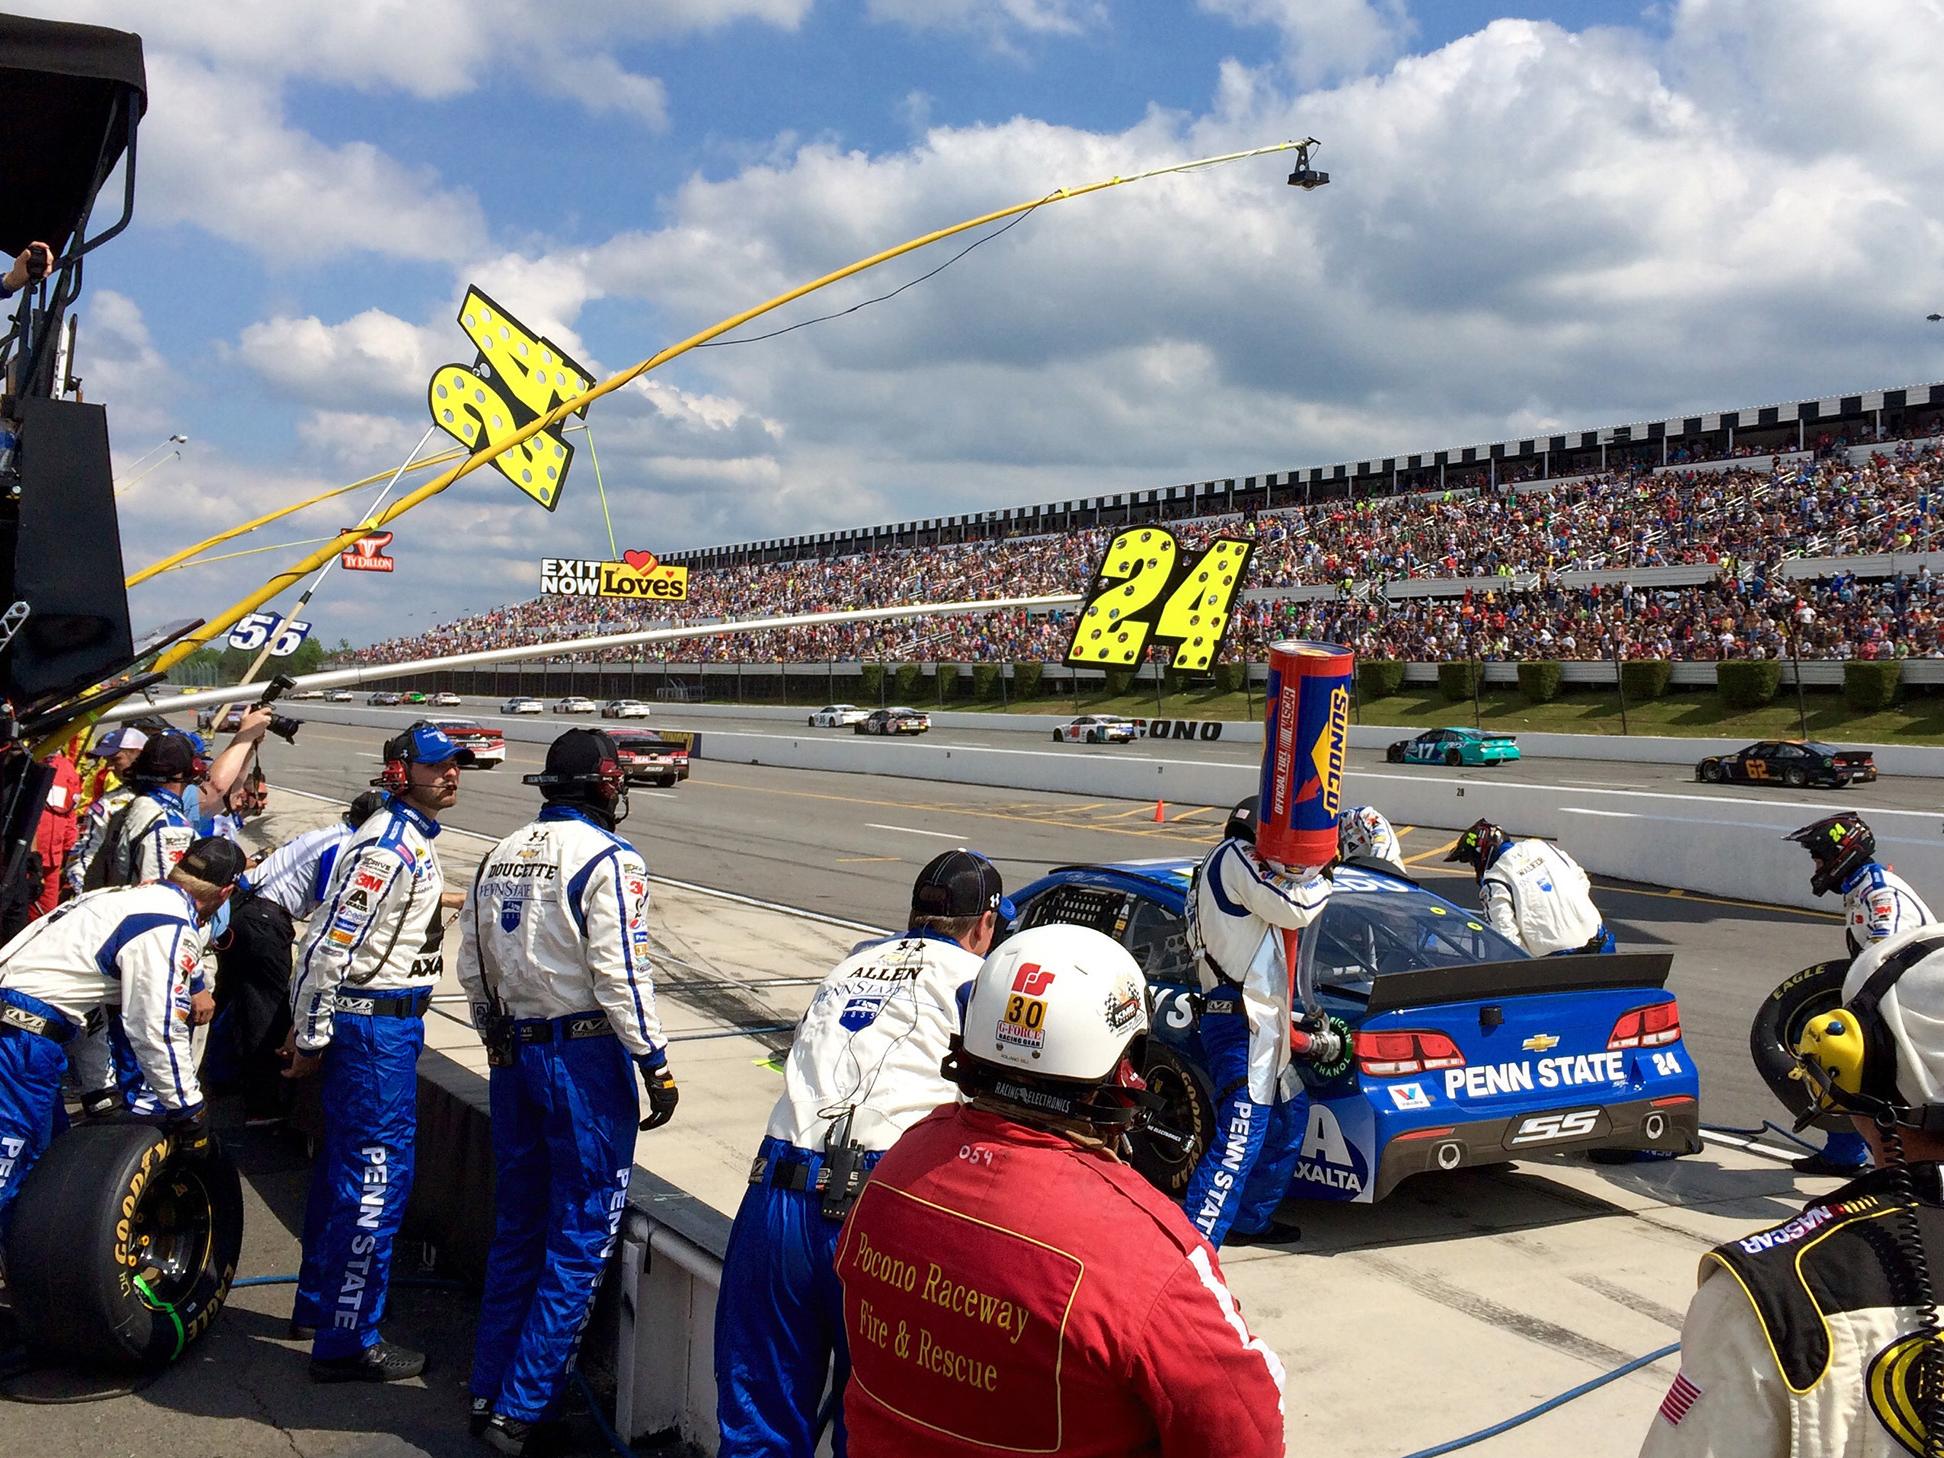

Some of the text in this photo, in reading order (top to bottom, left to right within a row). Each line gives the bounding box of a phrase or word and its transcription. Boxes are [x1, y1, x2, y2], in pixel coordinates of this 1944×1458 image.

[431, 292, 593, 509] 24
[358, 555, 393, 570] DILLON
[543, 559, 601, 578] EXIT
[542, 576, 600, 596] NOW
[1071, 529, 1247, 670] 24
[229, 613, 308, 657] 55
[1274, 685, 1297, 815] OFFICIAL FUEL NASCAR
[1326, 690, 1347, 811] SUNOCO
[1417, 743, 1436, 760] 17
[1745, 759, 1769, 779] 62
[1466, 831, 1478, 847] 24
[1829, 822, 1847, 843] 24
[355, 872, 383, 893] 3M
[487, 862, 559, 880] DOUCETTE
[847, 966, 924, 982] ALLEN
[1772, 964, 1828, 1001] EAGLE
[1008, 996, 1043, 1029] 30
[998, 1021, 1042, 1041] G-FORCE
[998, 1034, 1041, 1048] RACING GEAR
[1312, 1057, 1351, 1078] THANOL
[1445, 1051, 1626, 1099] PENN STATE
[1652, 1052, 1682, 1076] 24
[994, 1081, 1071, 1113] RACING ELECTRONICS
[1221, 1100, 1253, 1171] PENN
[1511, 1109, 1601, 1144] SS
[600, 1167, 631, 1258] PENN
[334, 1145, 388, 1331] PENN STATE
[1739, 1205, 1834, 1254] NASCAR
[187, 1262, 235, 1343] EAGLE
[853, 1231, 1030, 1345] Pocono Raceway
[859, 1298, 998, 1392] Fire & Rescue
